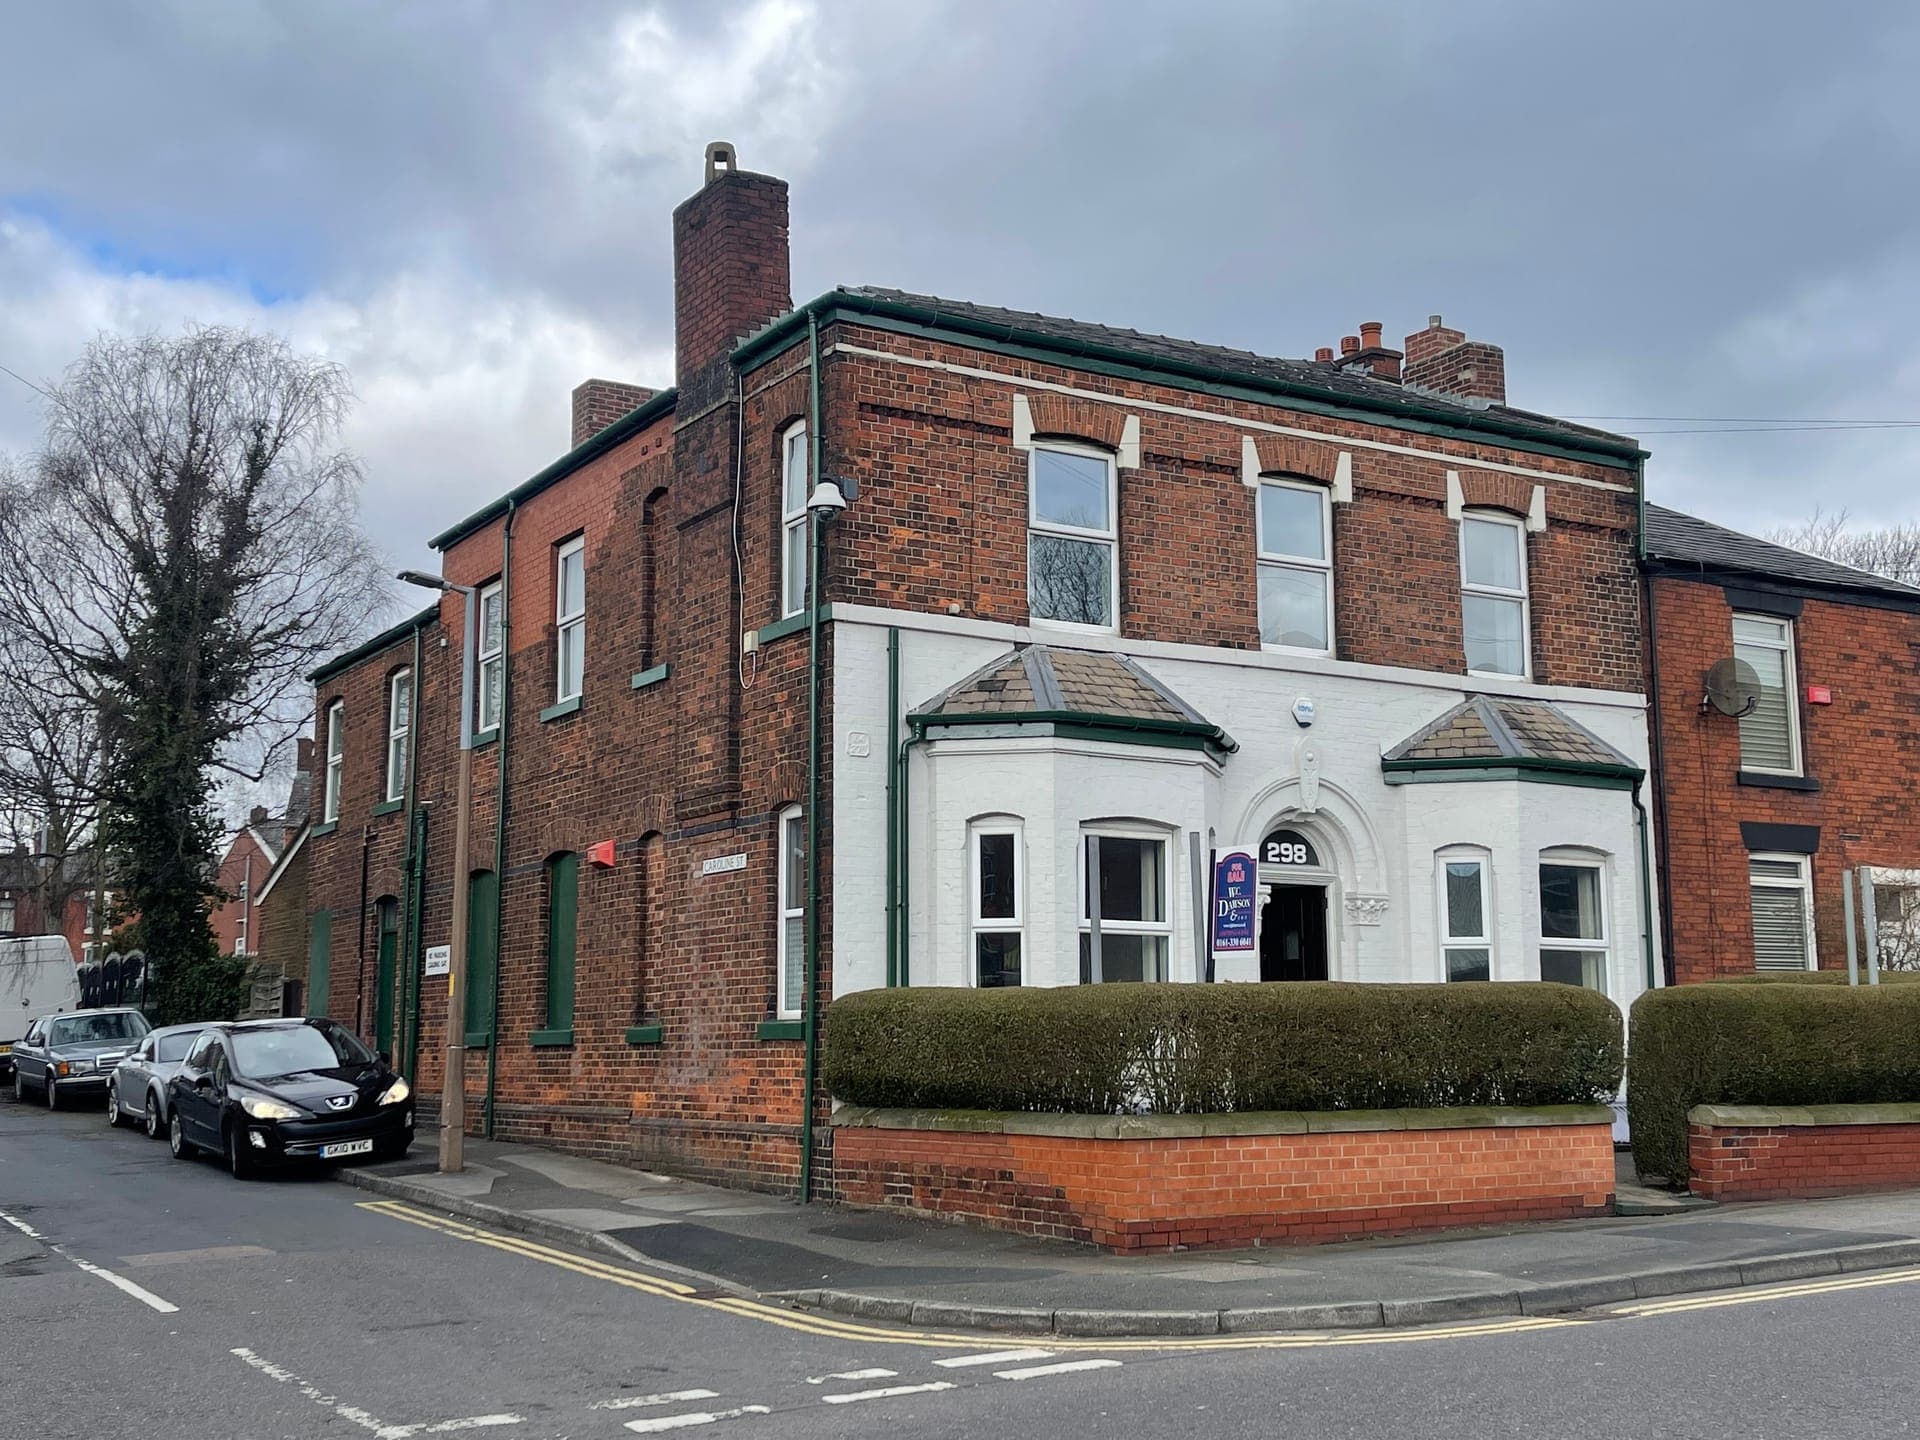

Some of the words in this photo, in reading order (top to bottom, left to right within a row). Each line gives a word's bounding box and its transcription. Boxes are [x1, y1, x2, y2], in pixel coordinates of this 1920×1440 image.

[1267, 842, 1307, 864] 298
[704, 857, 735, 872] CAROLINE
[736, 855, 744, 868] ST
